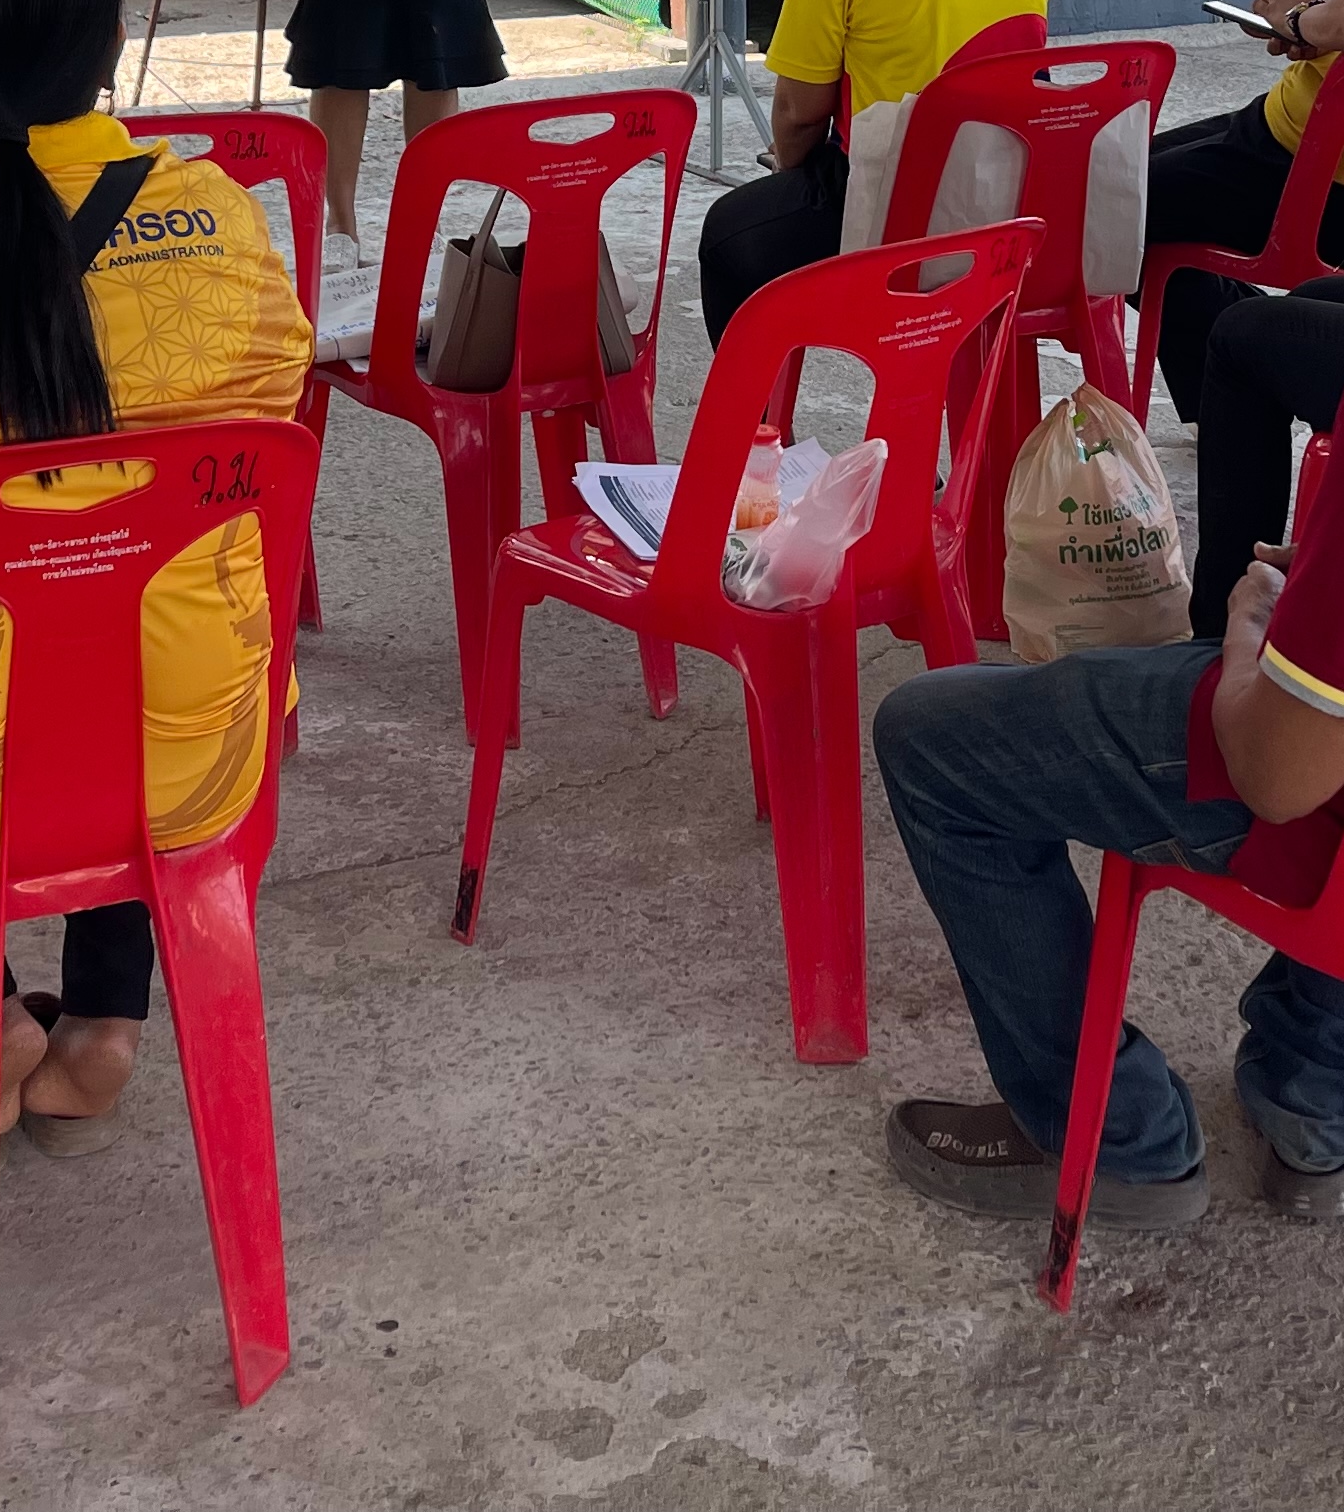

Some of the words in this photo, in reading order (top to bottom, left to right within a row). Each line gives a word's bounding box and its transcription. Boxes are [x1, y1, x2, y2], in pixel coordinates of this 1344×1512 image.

[108, 243, 225, 271] ADMINISTRATION
[191, 450, 261, 505] ว.ม.
[1059, 525, 1172, 565] ทำเพื่อโลก
